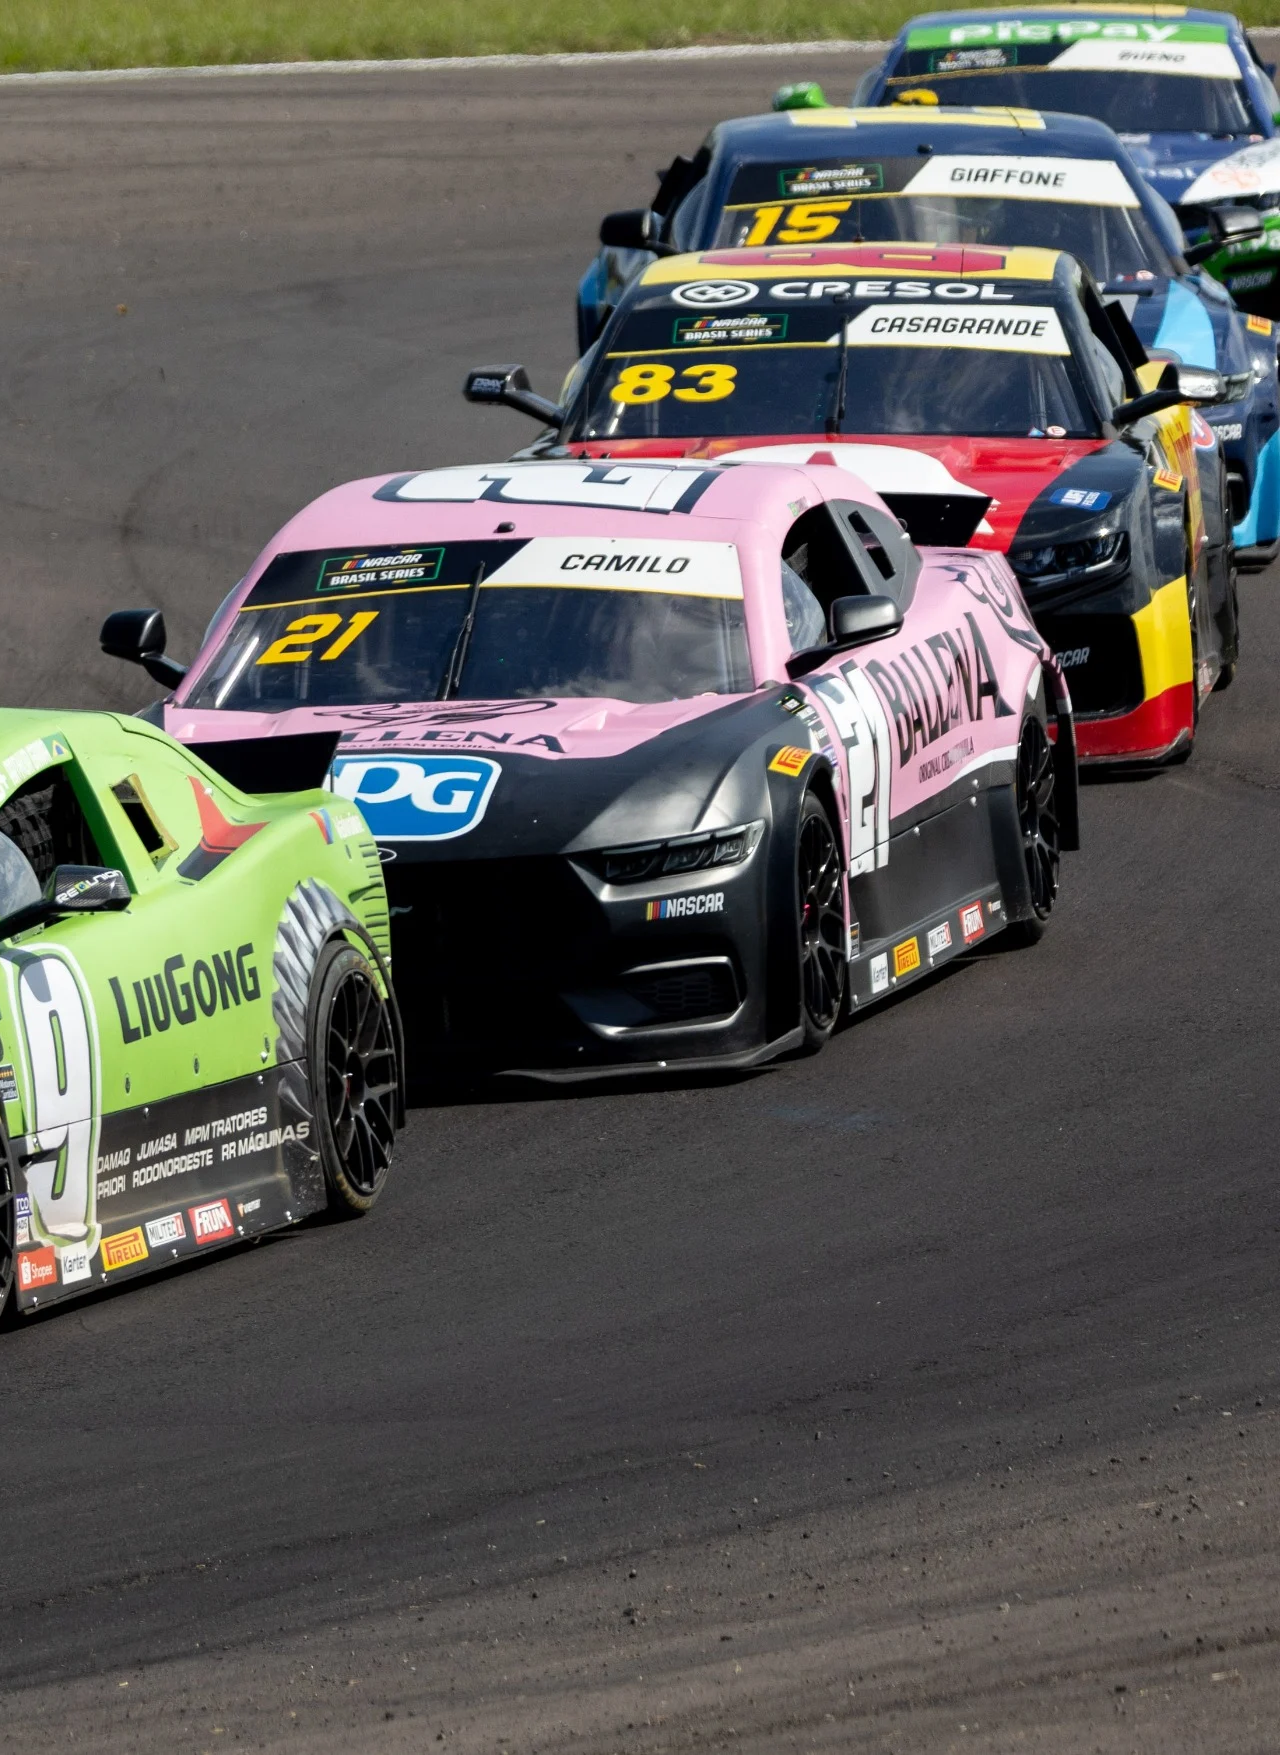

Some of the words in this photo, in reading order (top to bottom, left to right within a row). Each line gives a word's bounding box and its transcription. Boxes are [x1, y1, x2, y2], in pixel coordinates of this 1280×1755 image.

[949, 20, 1182, 43] PicPay
[812, 167, 865, 181] NASCAR
[833, 177, 872, 191] SERIES
[951, 167, 1067, 188] GIAFFONE
[741, 201, 852, 247] 15
[768, 280, 1015, 300] CRESOL
[684, 328, 728, 341] BRASIL
[730, 326, 773, 339] SERIES
[712, 315, 769, 329] NASCAR
[871, 316, 1049, 338] CASAGRANDE
[609, 363, 739, 405] 83
[361, 553, 423, 569] NASCAR
[561, 553, 692, 574] CAMILO
[330, 571, 377, 587] BRASIL
[379, 567, 425, 582] SERIES
[256, 610, 380, 665] 21
[866, 611, 1017, 769] BALLENA
[339, 730, 566, 754] LLENA
[665, 892, 725, 918] NASCAR
[897, 942, 917, 972] PIRELLI
[20, 953, 94, 1240] 9
[136, 1132, 178, 1161] JUMASA
[184, 1122, 211, 1147] MPM
[210, 1106, 269, 1139] TRATORES
[96, 1174, 126, 1200] PRIORI
[132, 1148, 214, 1188] RODONORDESTE
[221, 1141, 237, 1162] RR
[238, 1121, 310, 1155] MÁQUINAS
[195, 1202, 232, 1238] FRUM
[105, 1231, 143, 1266] PIRELLI
[31, 1261, 53, 1279] Shopee
[62, 1255, 87, 1274] Karter
